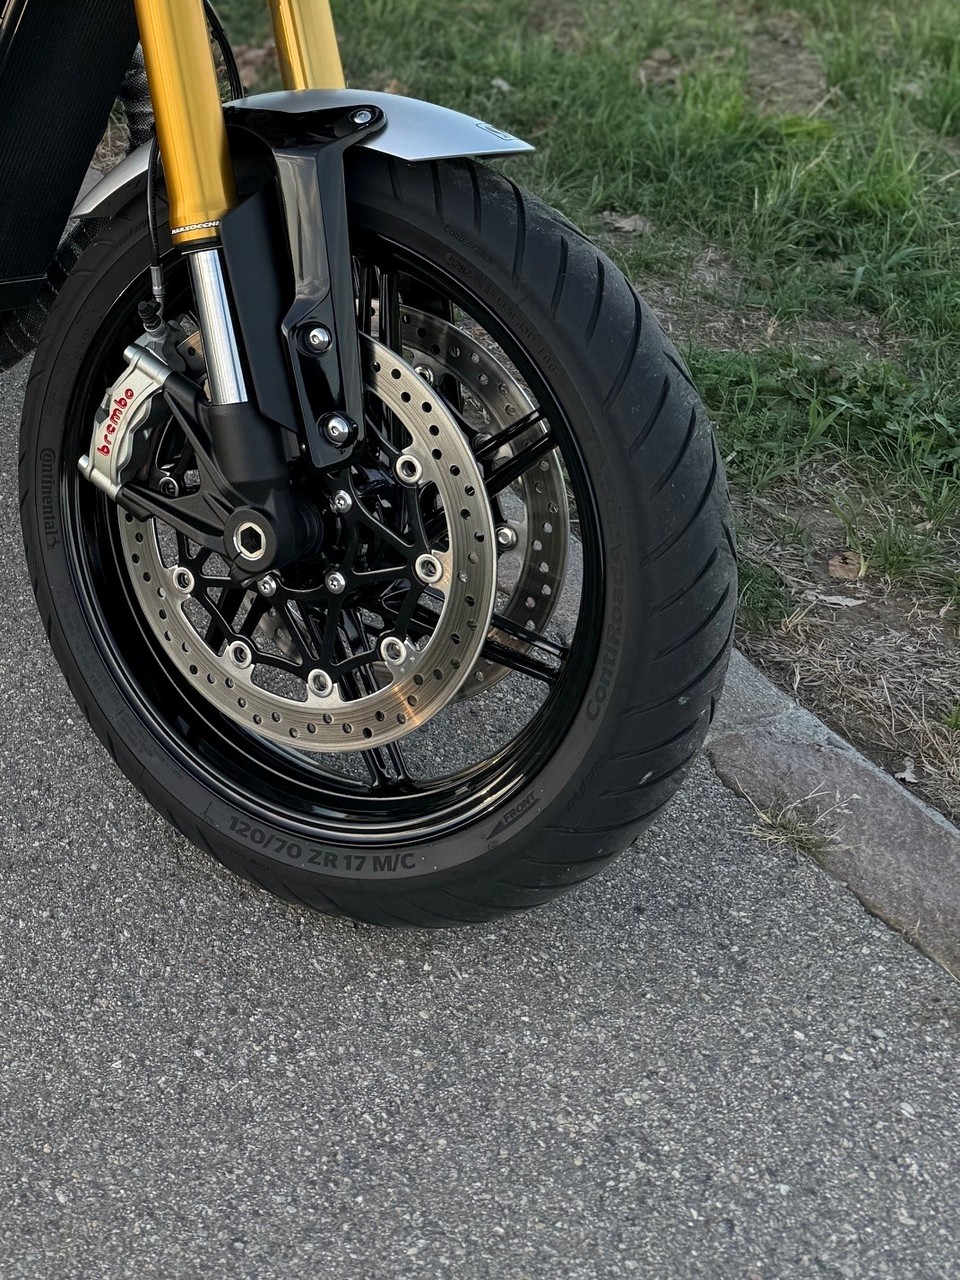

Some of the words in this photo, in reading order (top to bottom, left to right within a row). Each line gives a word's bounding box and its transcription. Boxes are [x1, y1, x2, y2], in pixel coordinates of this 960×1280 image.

[96, 387, 135, 457] brembo
[40, 446, 60, 551] Continental
[503, 790, 536, 823] FRONT
[228, 815, 303, 860] 120/70
[307, 848, 338, 870] ZR
[343, 854, 367, 872] 17
[372, 852, 416, 873] M/C
